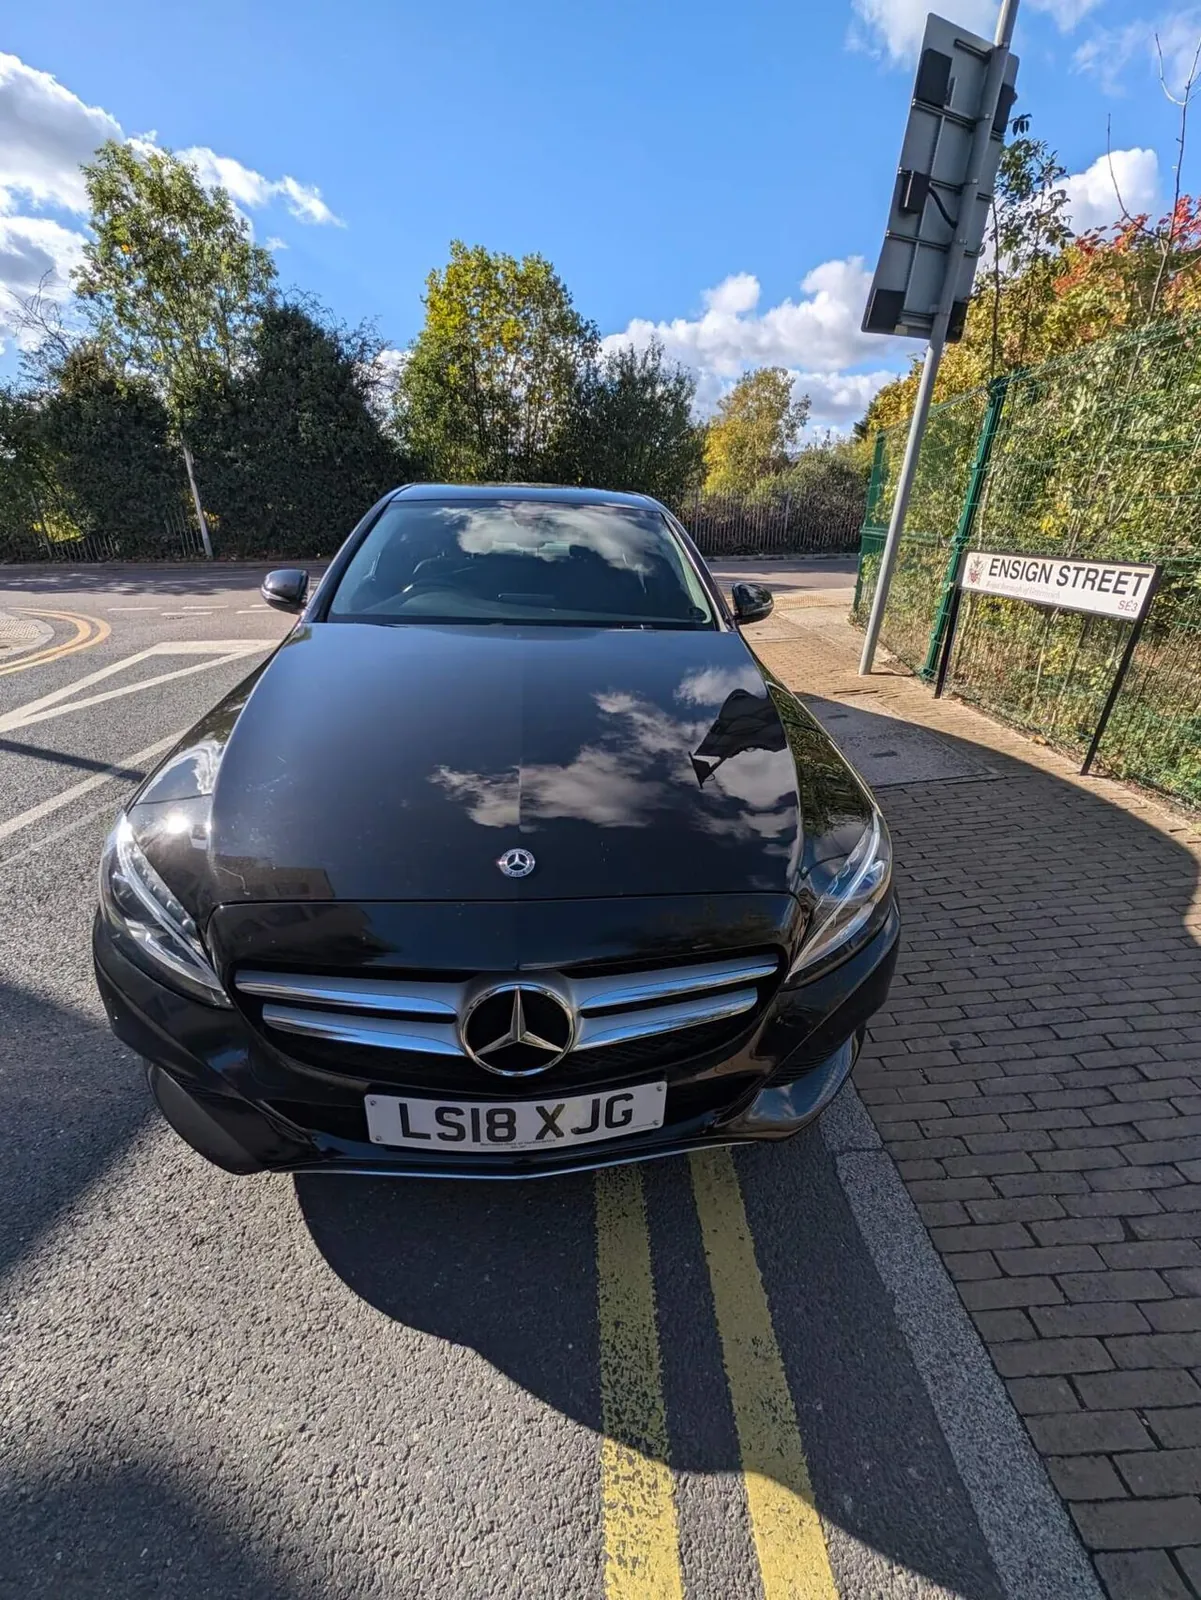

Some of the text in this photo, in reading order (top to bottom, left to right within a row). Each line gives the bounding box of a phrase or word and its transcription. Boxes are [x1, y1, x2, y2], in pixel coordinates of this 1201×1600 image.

[989, 558, 1053, 584] ENSIGN
[1056, 565, 1149, 597] STREET
[1118, 600, 1138, 612] SE3
[399, 1093, 635, 1142] LS18 XJG
